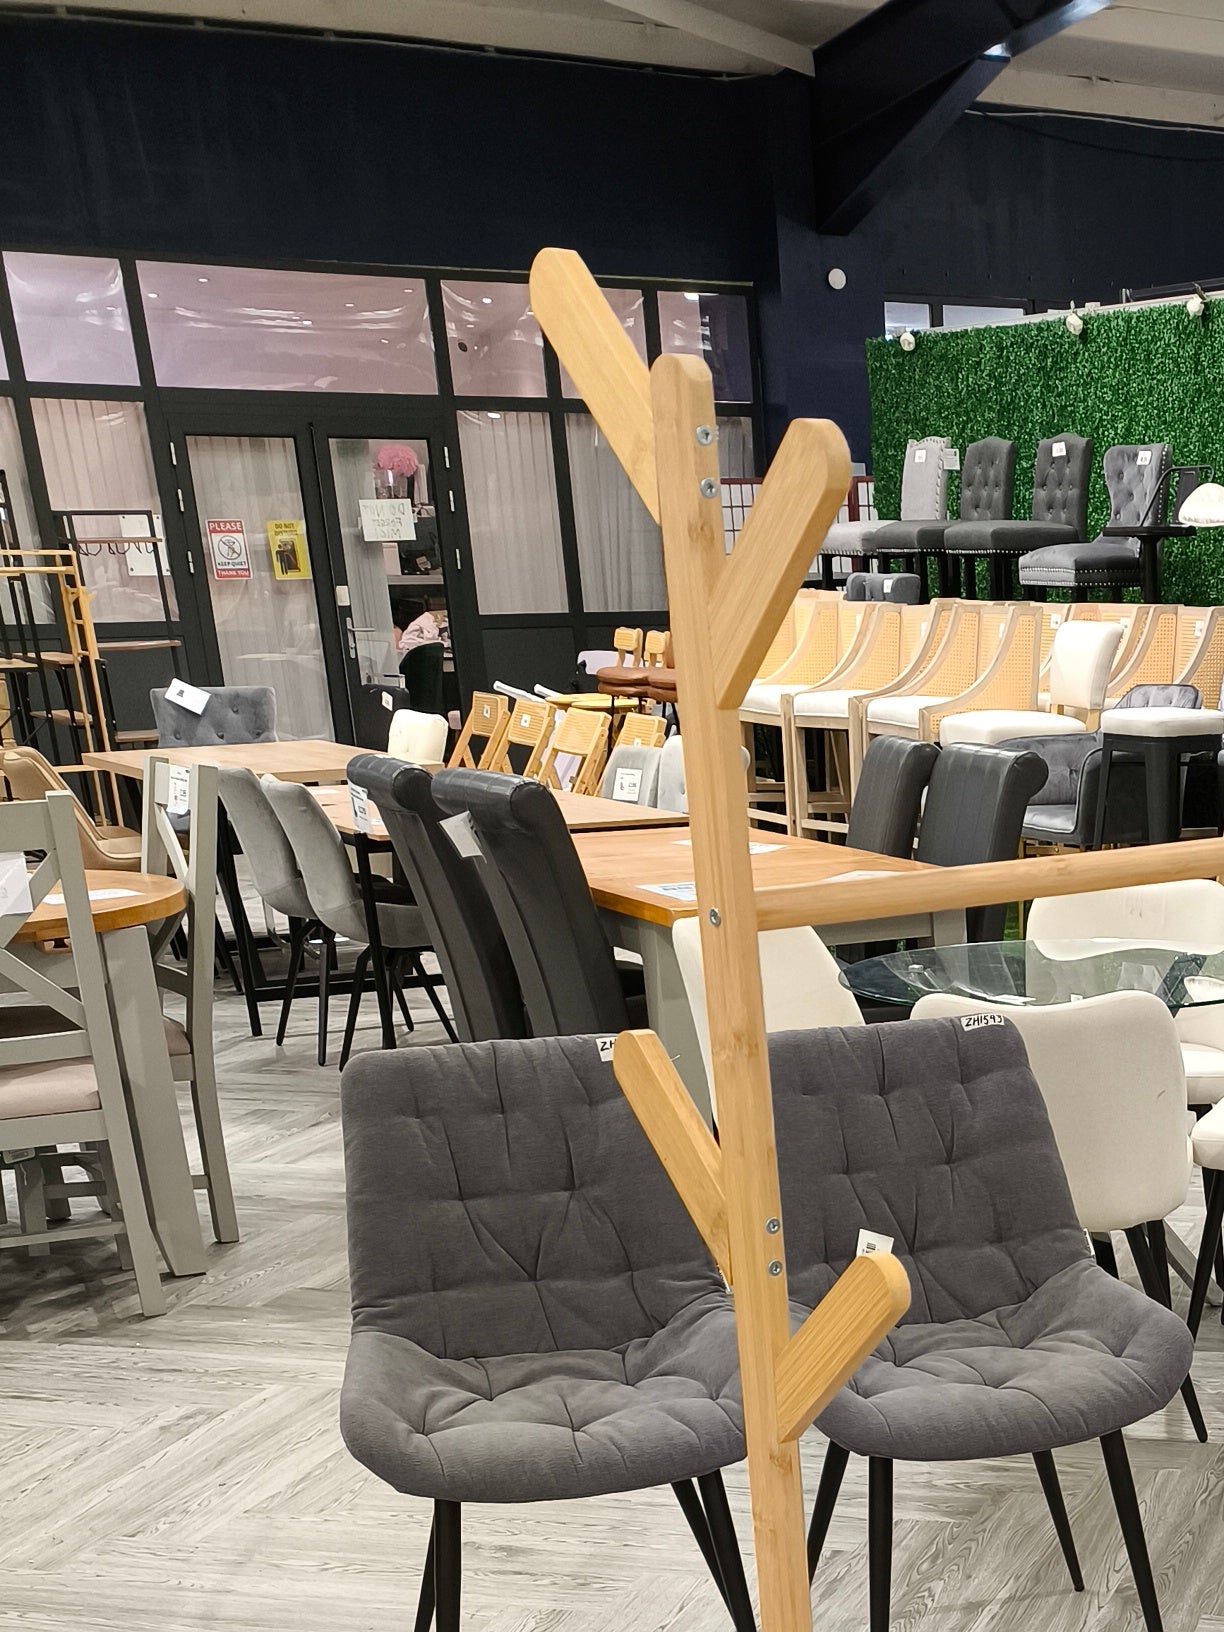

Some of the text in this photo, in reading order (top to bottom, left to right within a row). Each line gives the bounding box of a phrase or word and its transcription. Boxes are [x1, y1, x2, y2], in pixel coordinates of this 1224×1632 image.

[209, 521, 243, 531] PLEASE
[237, 569, 250, 577] YOU
[965, 1014, 1003, 1028] ZH1593
